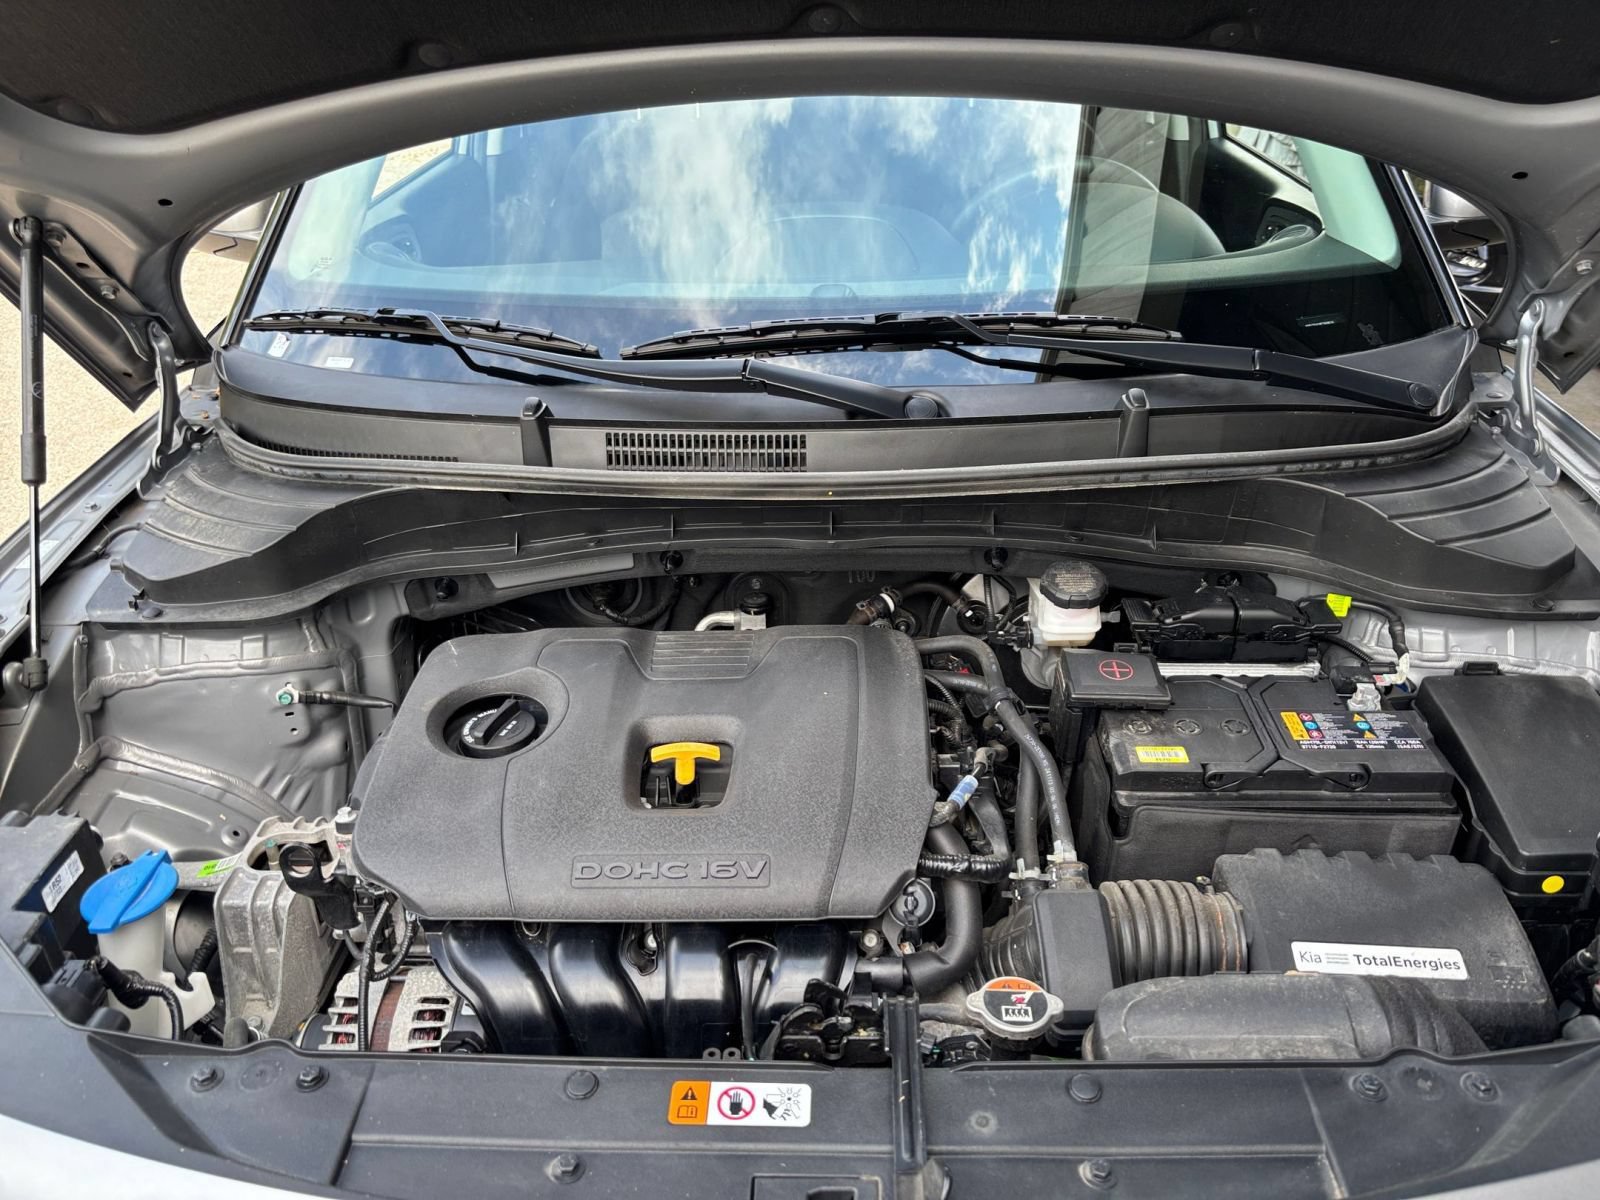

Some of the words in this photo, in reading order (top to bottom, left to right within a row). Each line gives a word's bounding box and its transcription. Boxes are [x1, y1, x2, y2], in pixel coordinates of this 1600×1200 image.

[574, 861, 690, 881] DOHC
[700, 860, 768, 880] 16V
[1299, 950, 1323, 964] Kia
[1353, 953, 1462, 972] TotalEnergies
